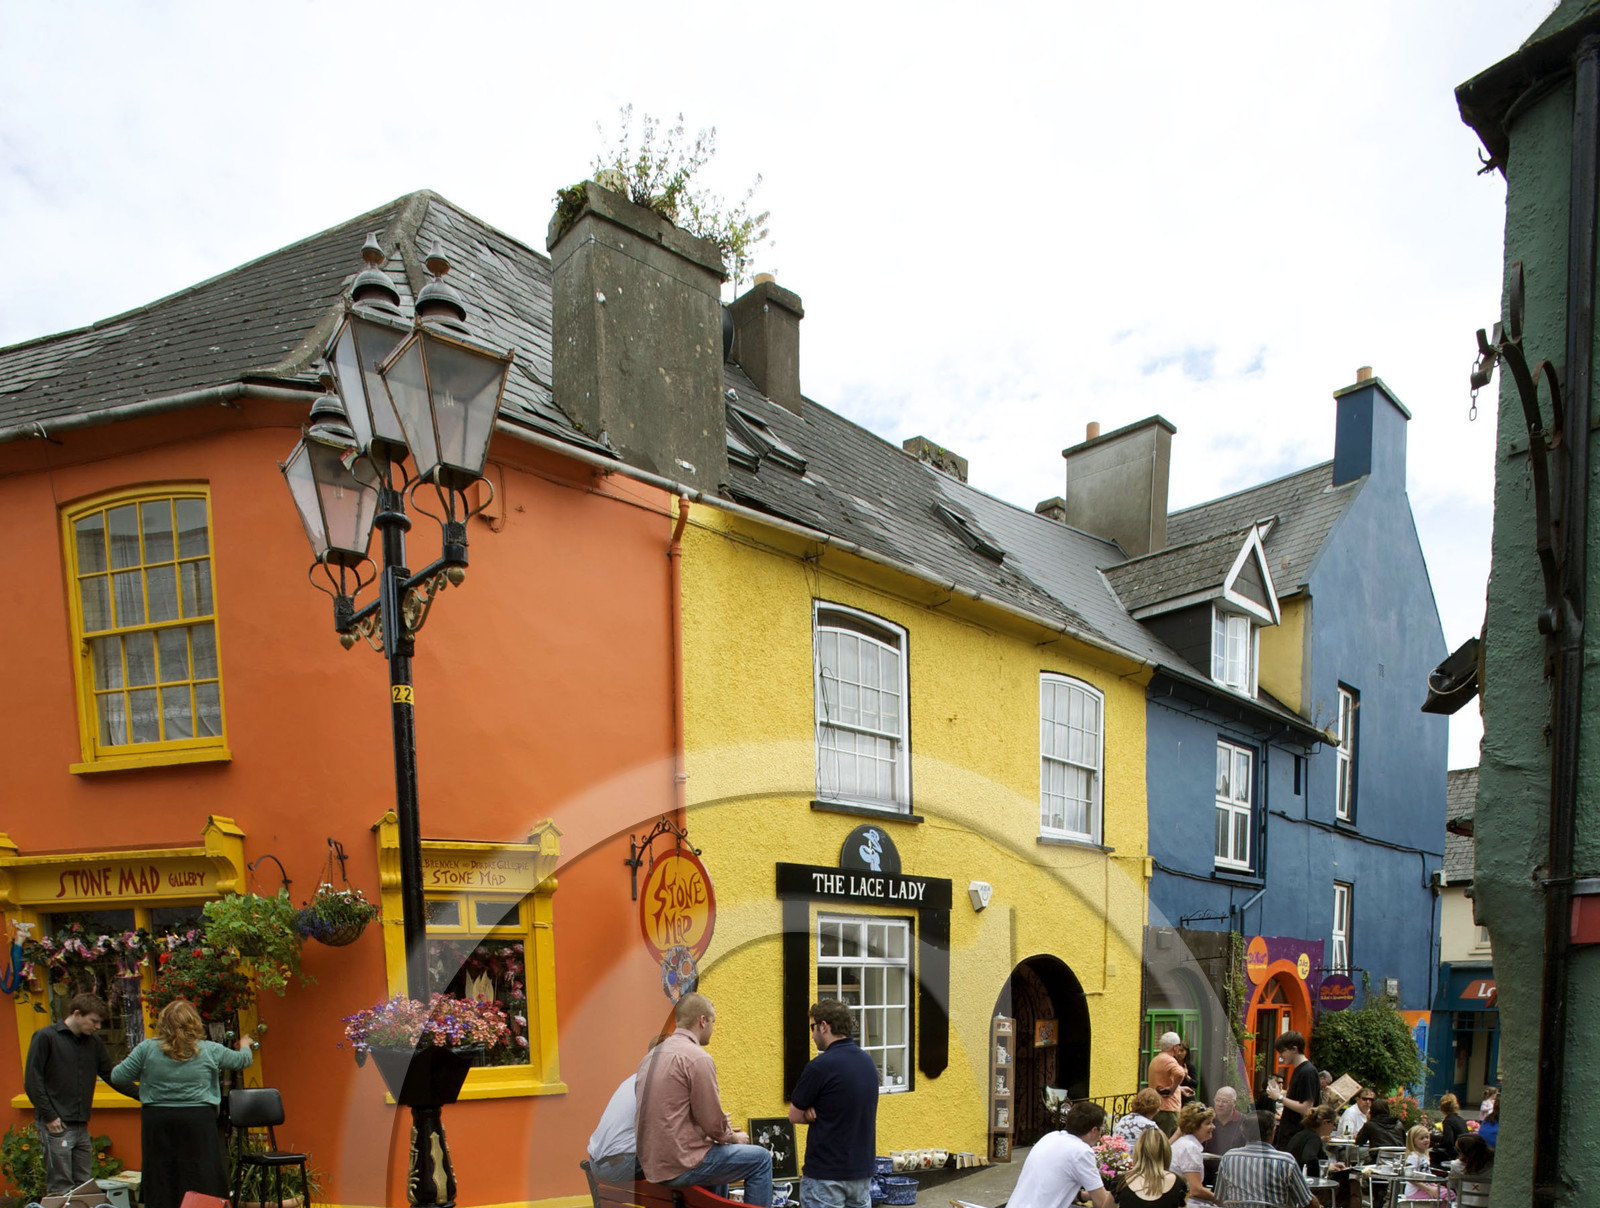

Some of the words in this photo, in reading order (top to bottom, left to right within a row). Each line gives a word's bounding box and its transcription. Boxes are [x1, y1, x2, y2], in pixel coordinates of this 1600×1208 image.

[393, 686, 411, 701] 22
[56, 867, 112, 898] STONE
[118, 865, 161, 896] MAD
[168, 871, 206, 888] GALLERY
[431, 869, 475, 885] STONE
[479, 870, 507, 886] MAD
[812, 872, 845, 895] THE
[850, 876, 885, 898] LACE
[888, 879, 927, 901] LADY
[651, 861, 707, 945] STONE
[663, 911, 693, 946] MAD
